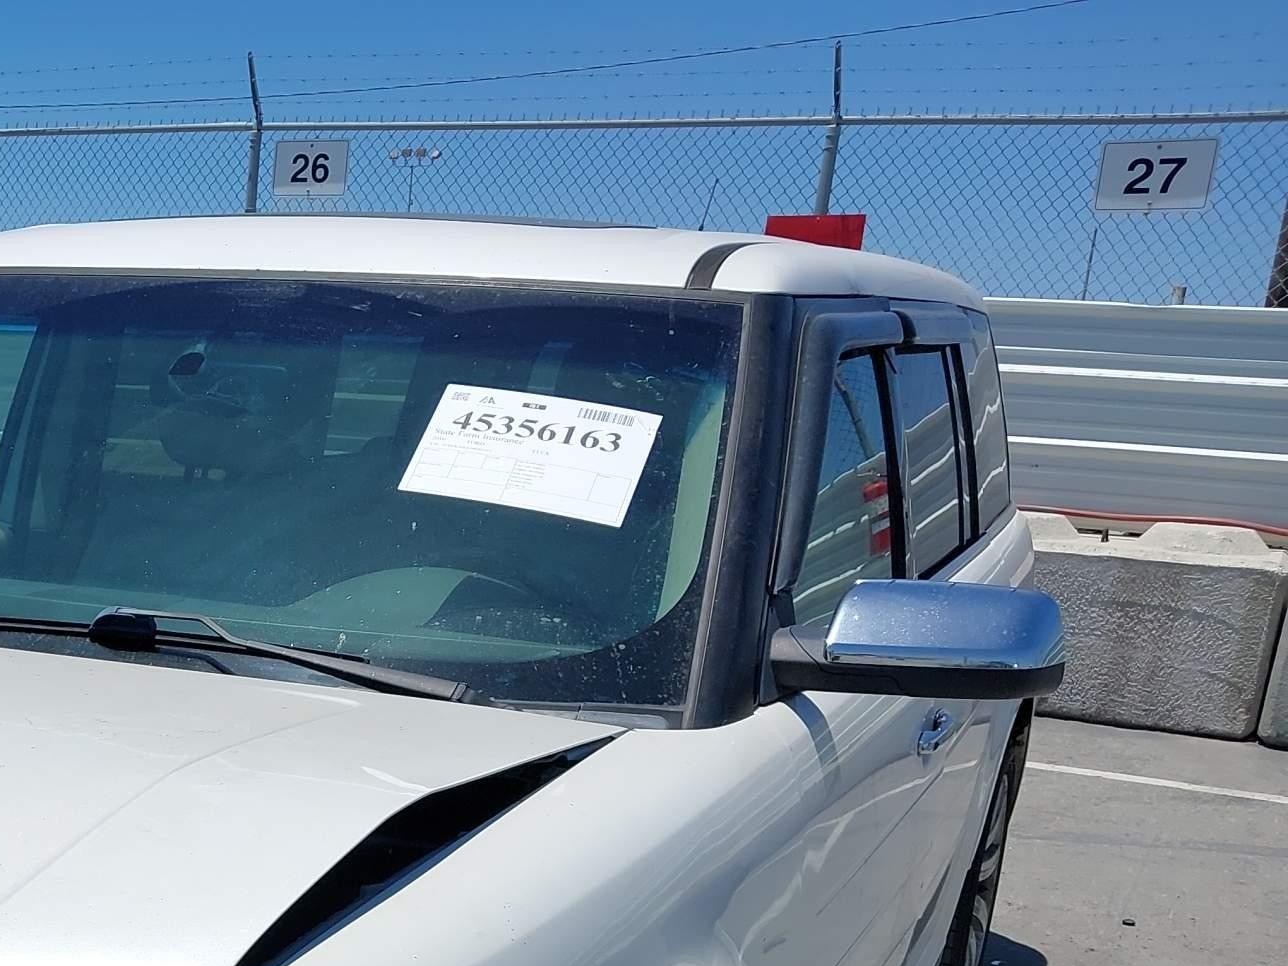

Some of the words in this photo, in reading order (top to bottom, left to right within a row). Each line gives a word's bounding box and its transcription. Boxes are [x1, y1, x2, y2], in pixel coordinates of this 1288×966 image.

[290, 153, 330, 184] 26
[1122, 157, 1188, 195] 27
[452, 411, 623, 453] 45356163
